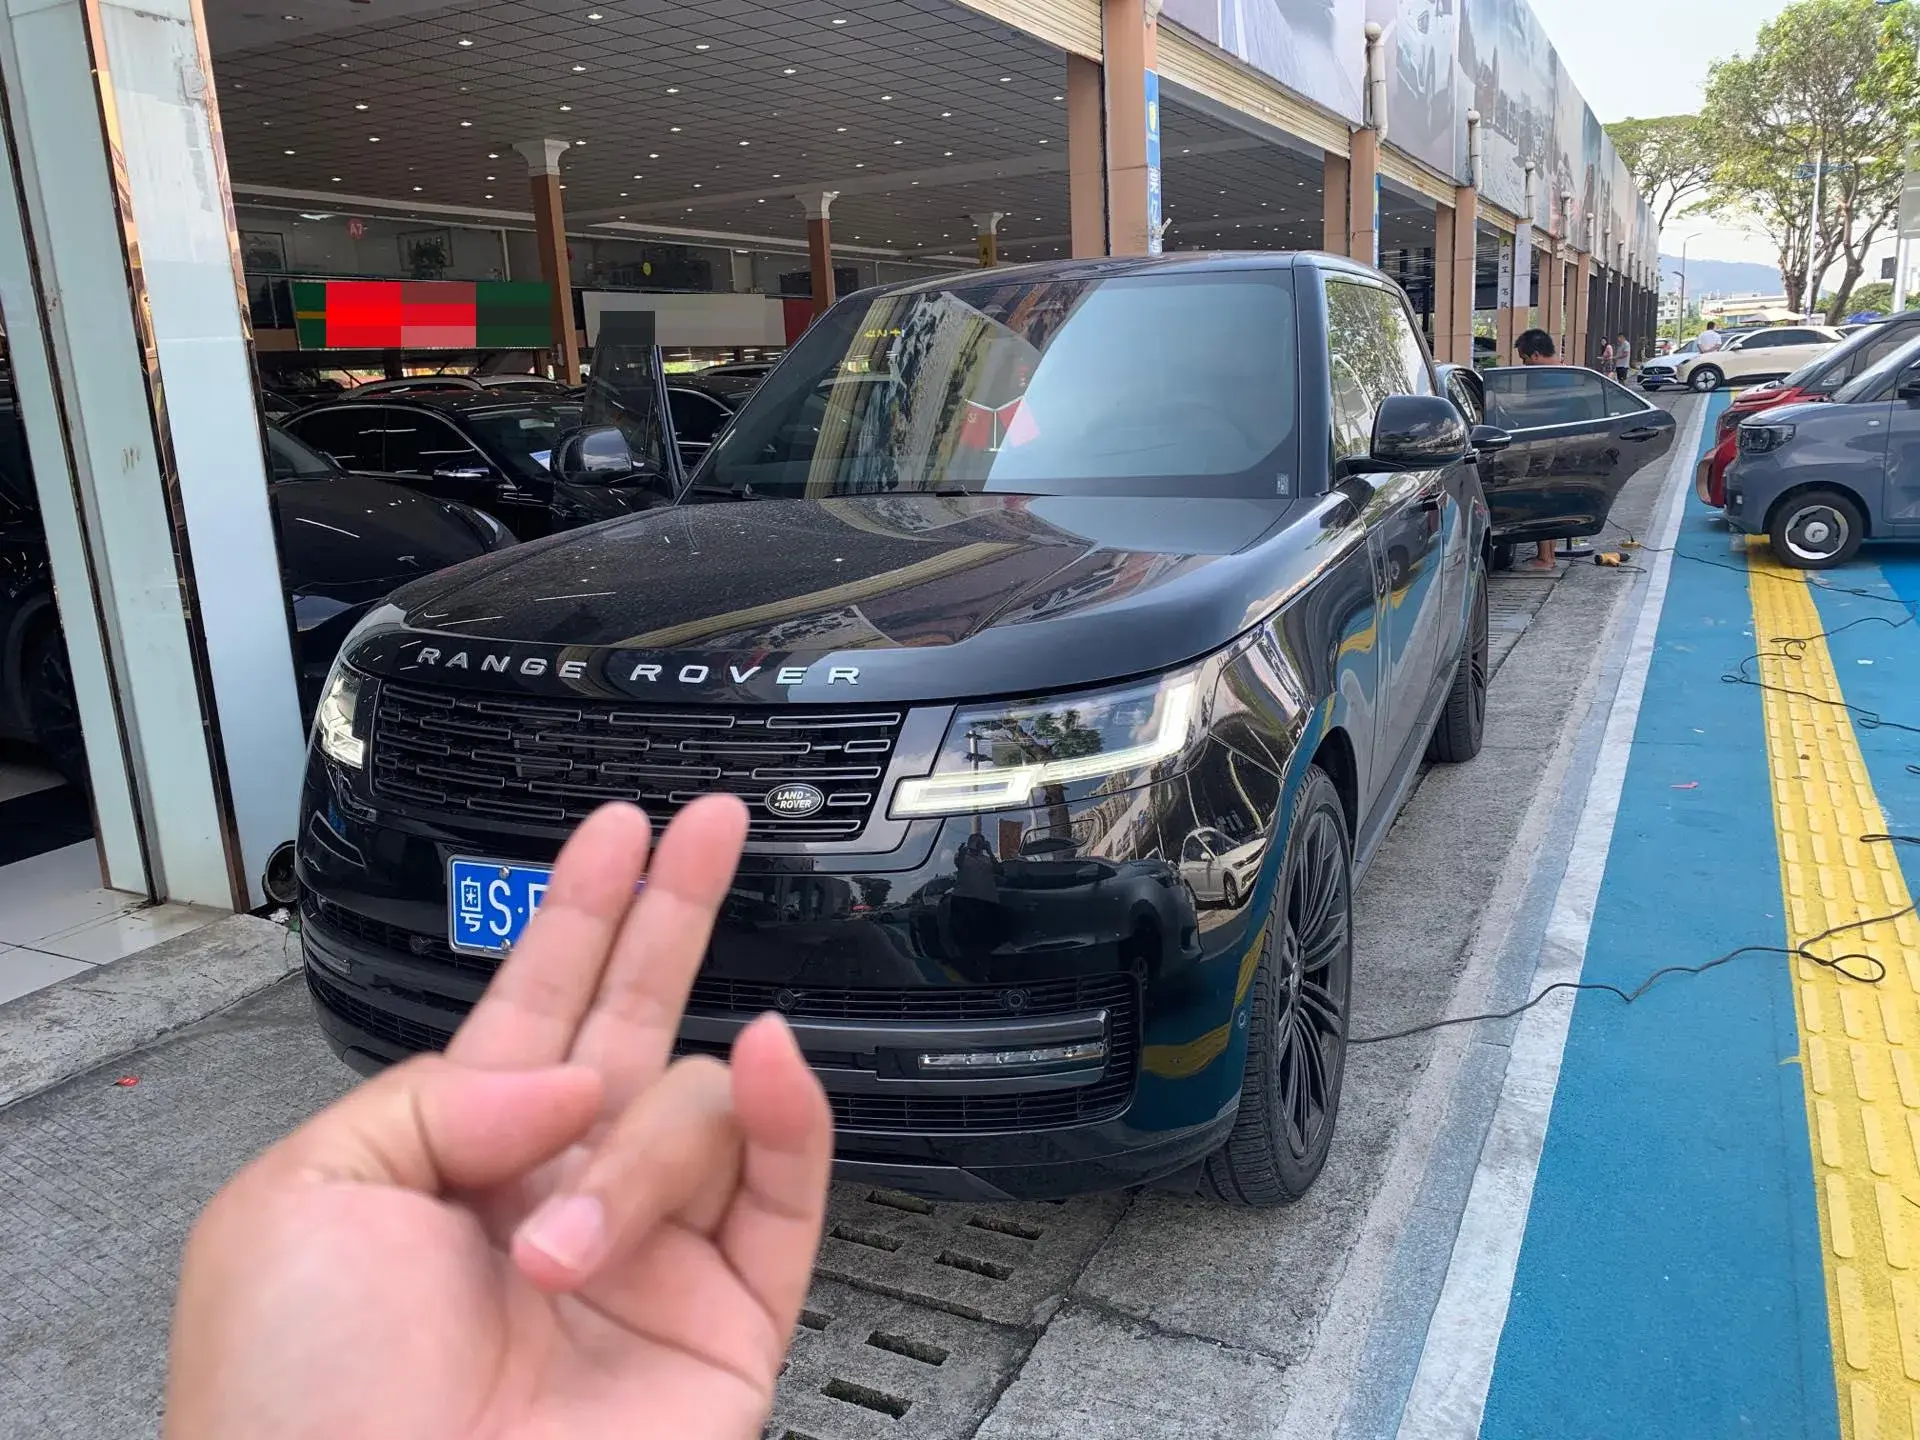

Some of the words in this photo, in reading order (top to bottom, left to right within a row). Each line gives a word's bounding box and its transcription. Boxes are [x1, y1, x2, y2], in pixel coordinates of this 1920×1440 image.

[416, 647, 588, 680] RANGE
[629, 664, 862, 686] ROVER
[777, 791, 803, 800] LAND
[780, 800, 812, 809] ROVER
